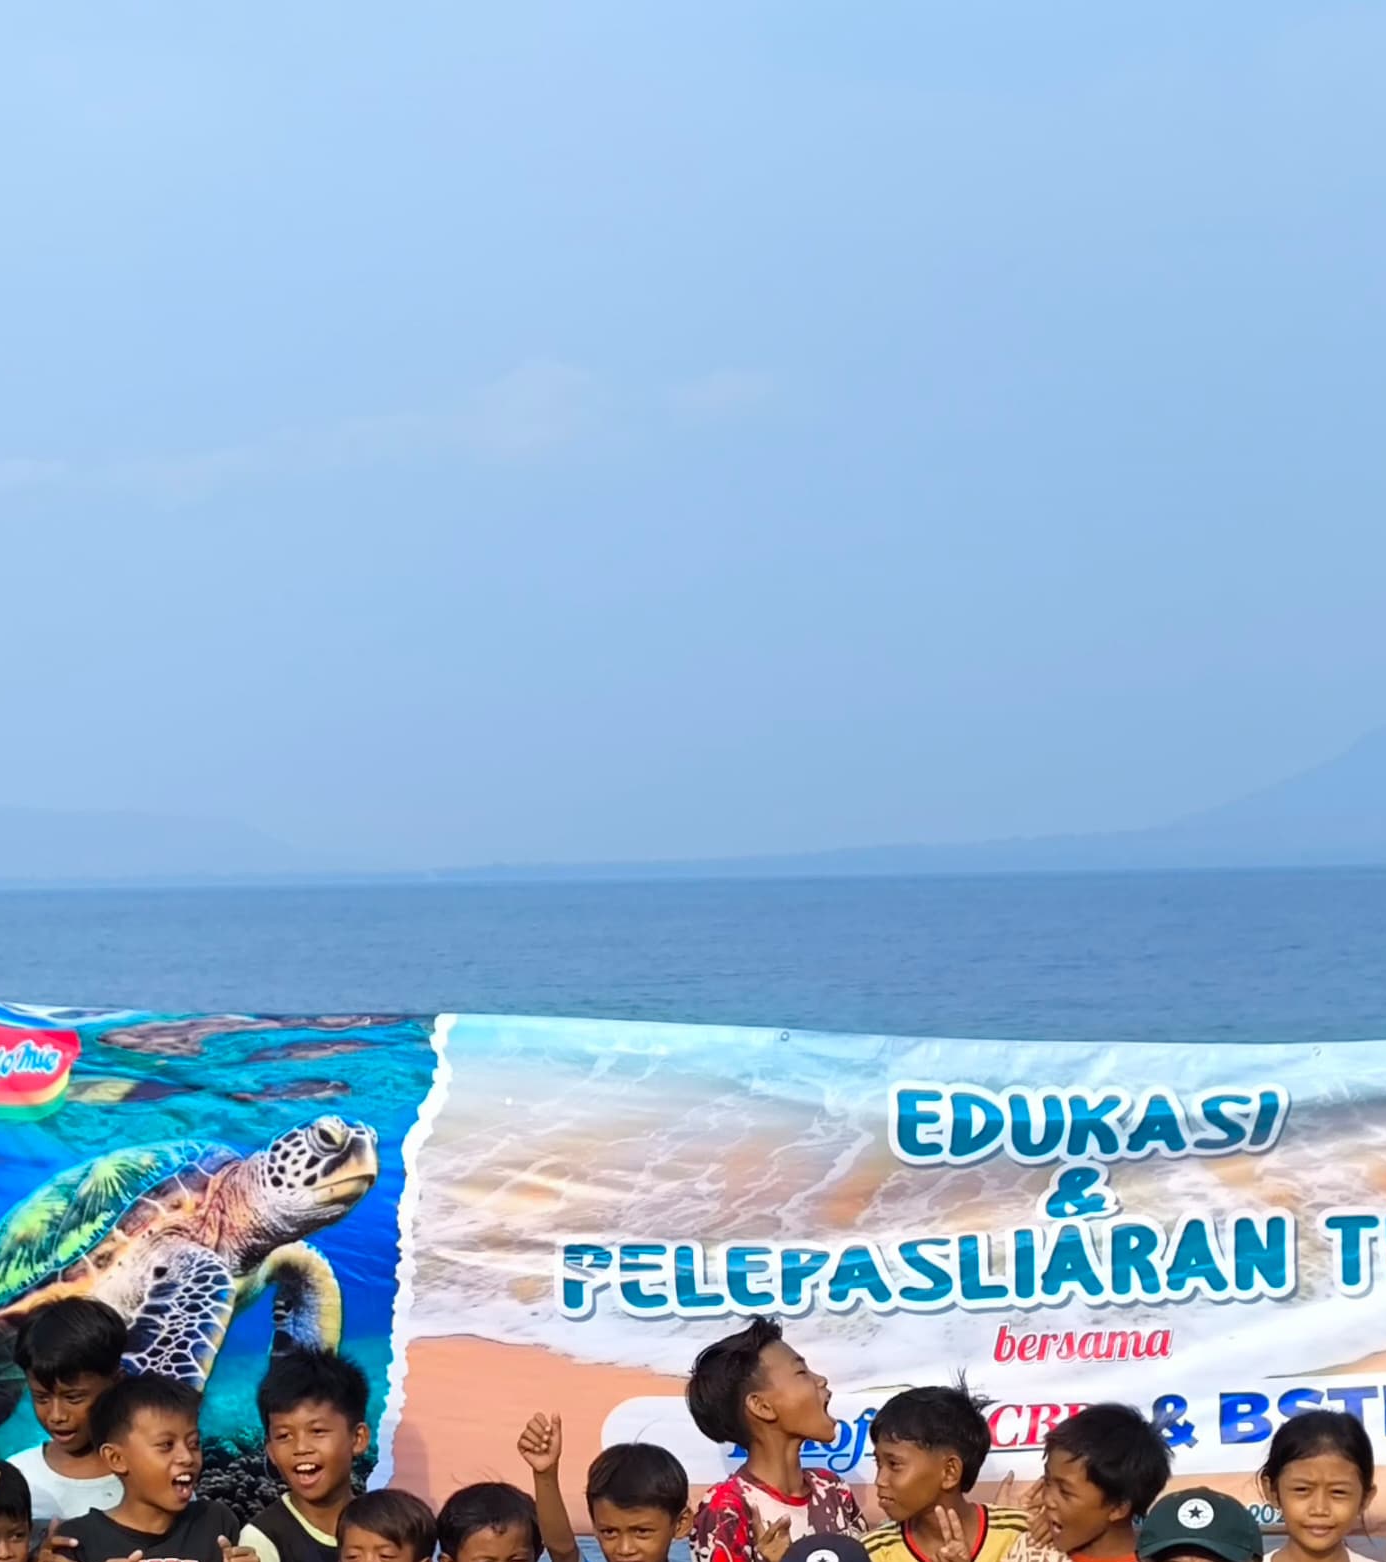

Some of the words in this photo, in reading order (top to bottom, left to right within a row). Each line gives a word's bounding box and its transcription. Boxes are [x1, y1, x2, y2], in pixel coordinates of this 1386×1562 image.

[894, 1087, 1282, 1158] EDUKASI
[1044, 1165, 1111, 1219] &
[561, 1215, 1290, 1310] PELEPASLIARAN
[993, 1322, 1173, 1363] bersama
